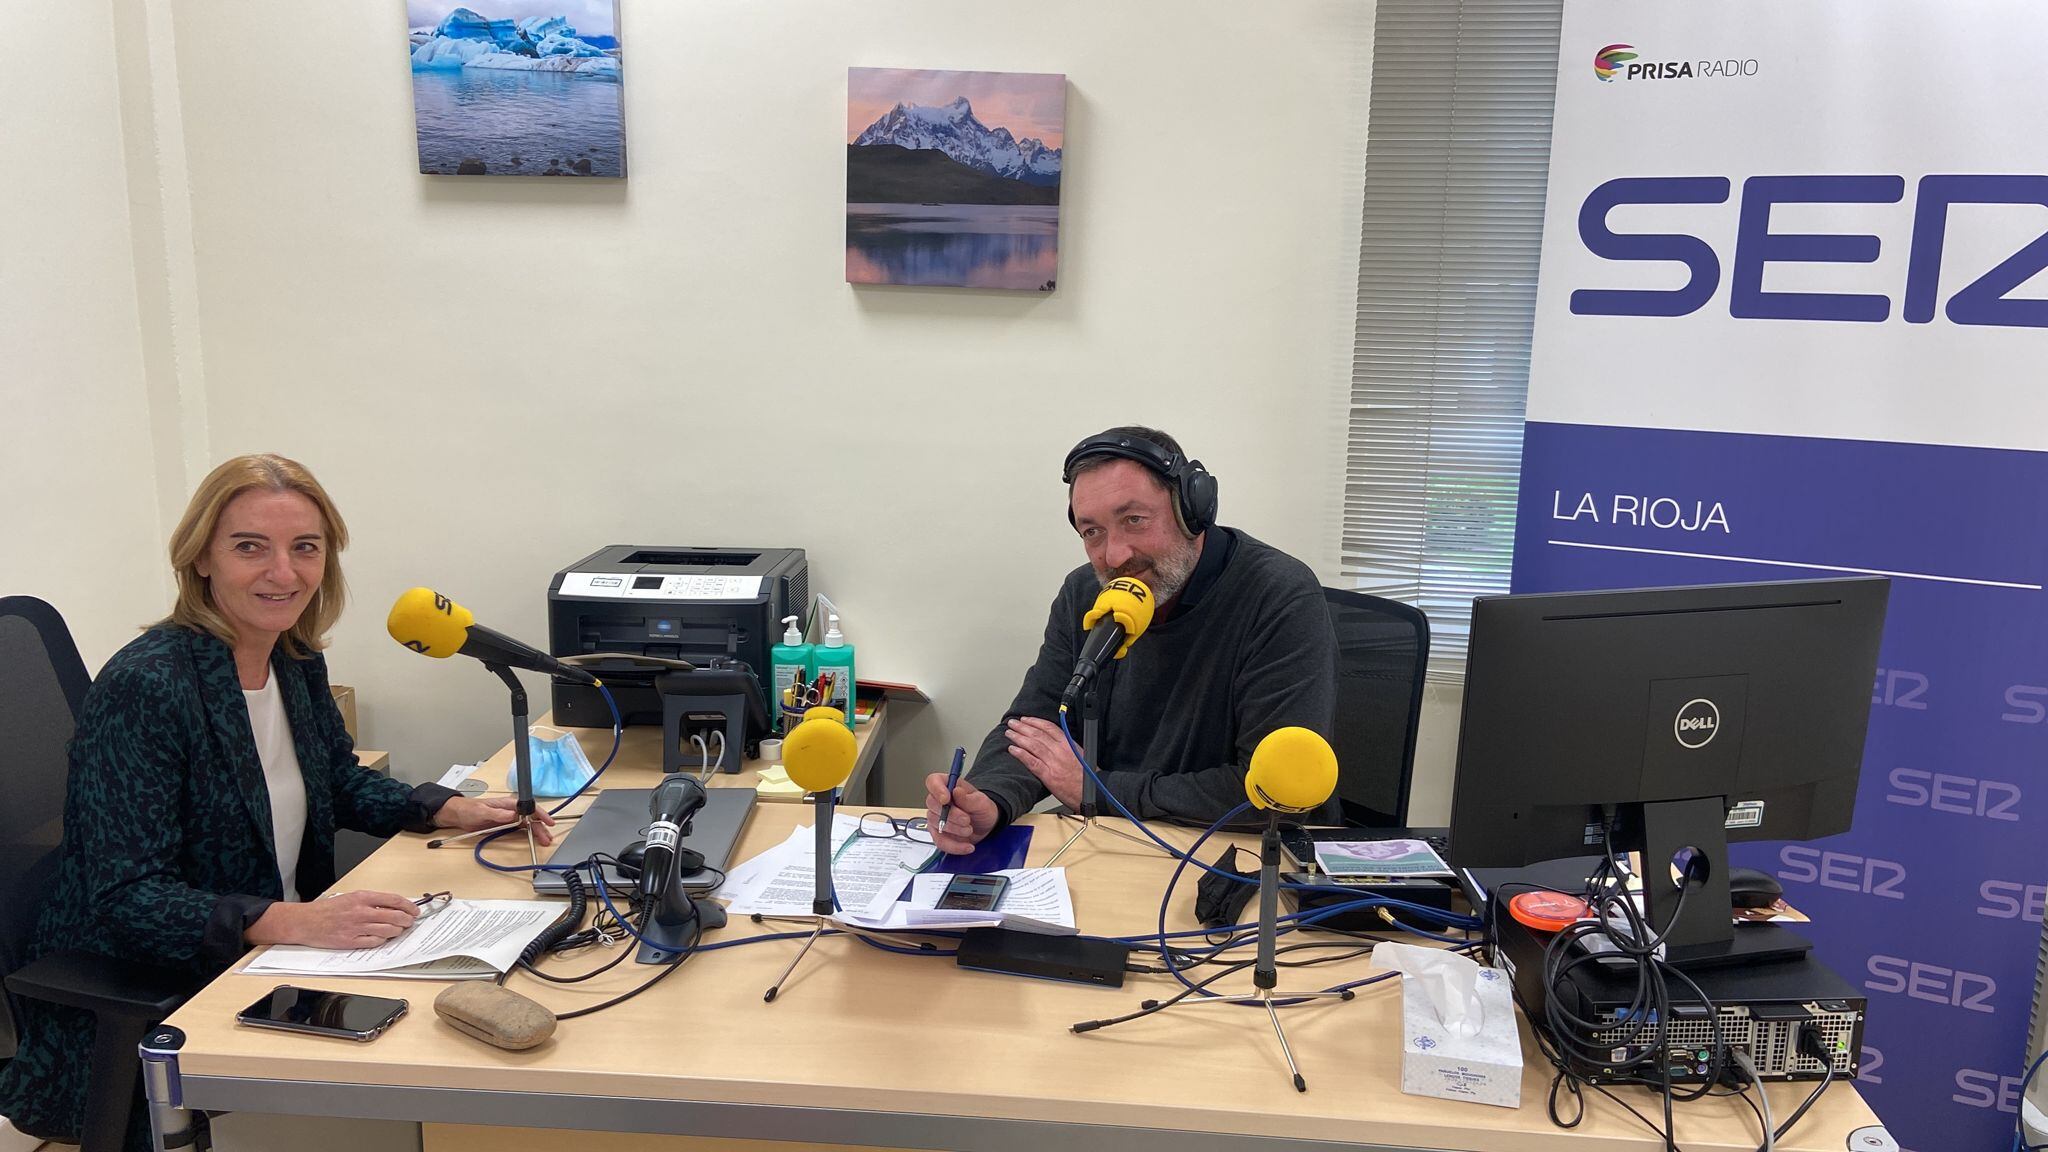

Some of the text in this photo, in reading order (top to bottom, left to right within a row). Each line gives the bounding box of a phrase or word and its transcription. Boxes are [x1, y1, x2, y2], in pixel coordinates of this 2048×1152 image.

[1627, 59, 1759, 80] PRISA RADIO
[1569, 174, 2048, 328] SER
[1553, 490, 1730, 534] LA RIOJA
[1680, 716, 1715, 731] DELL
[1886, 767, 2022, 822] SER
[1777, 845, 1906, 900] SER
[1977, 879, 2048, 923] SE
[1865, 955, 1997, 1013] SER
[1952, 1068, 2024, 1114] SE
